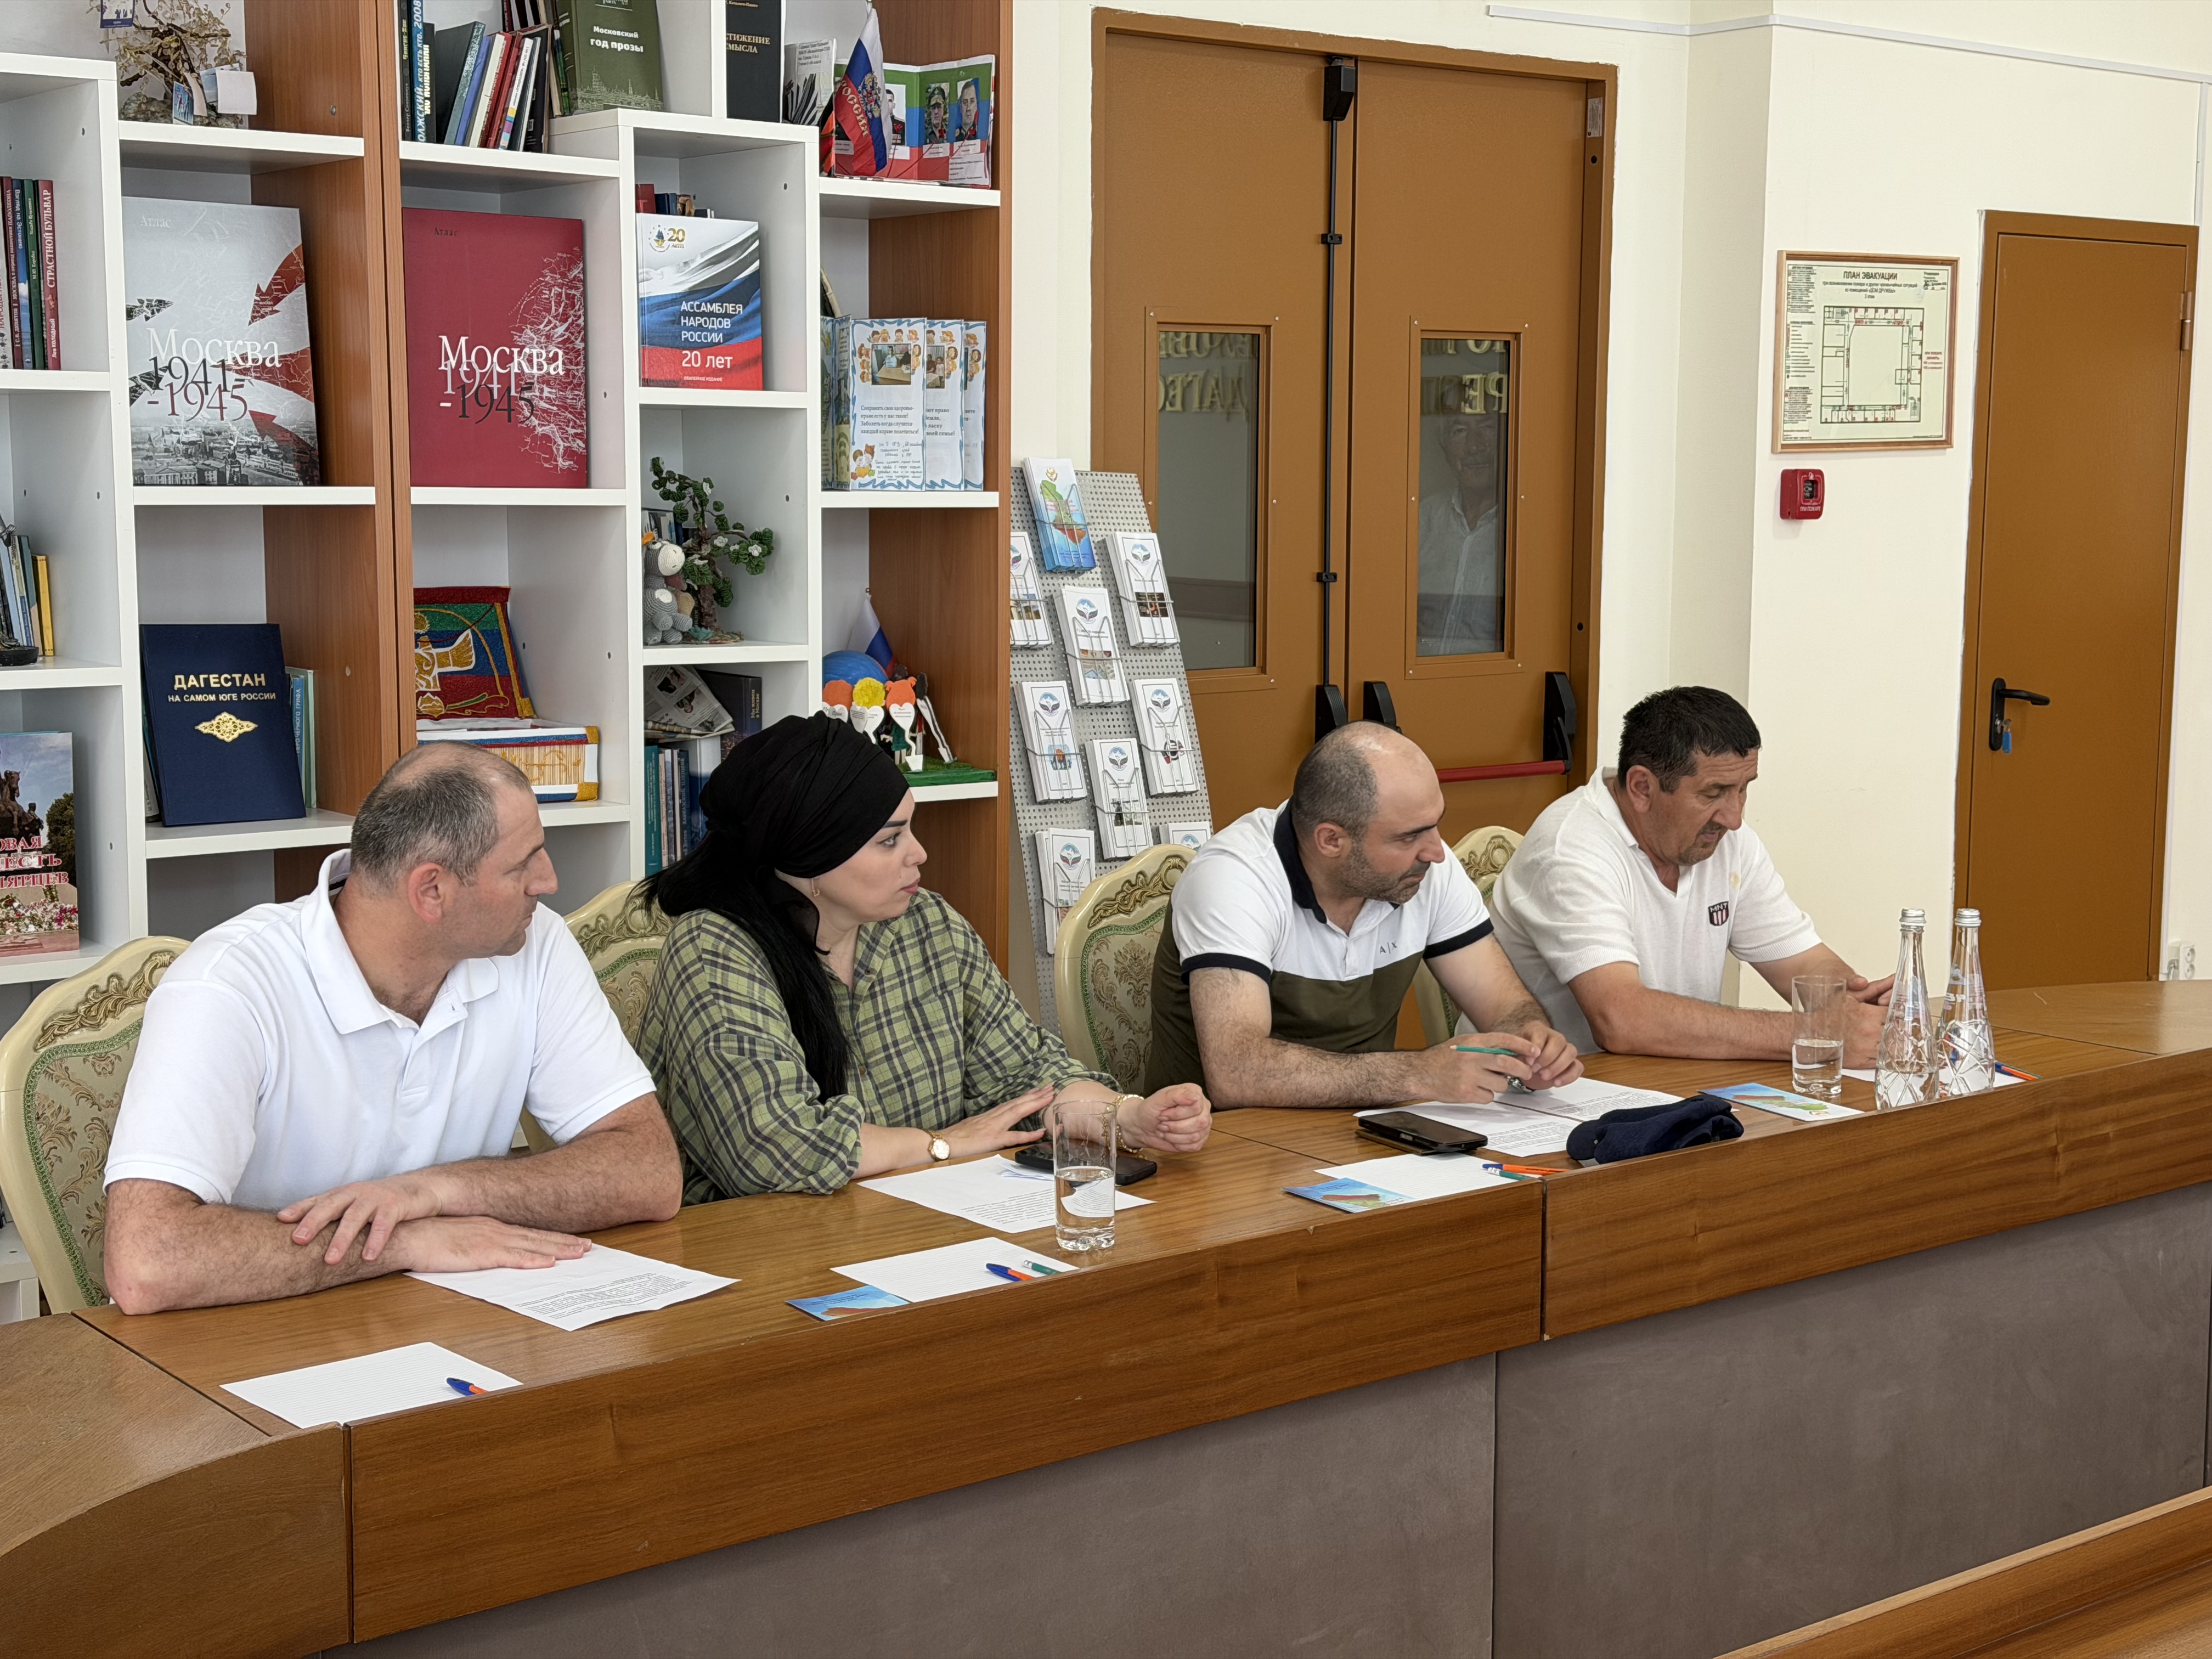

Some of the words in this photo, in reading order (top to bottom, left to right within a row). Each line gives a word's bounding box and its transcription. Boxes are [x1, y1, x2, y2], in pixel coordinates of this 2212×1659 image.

[413, 0, 422, 30] 2008
[593, 25, 639, 38] Московский
[590, 38, 610, 49] год
[611, 41, 644, 52] прозы
[43, 189, 53, 232] БУЛЬВАР
[667, 228, 686, 242] 20
[43, 233, 55, 288] СТРАСТНОЙ
[1861, 271, 1898, 281] ЭВАКУАЦИИ
[680, 301, 743, 314] АССАМБЛЕЯ
[681, 315, 731, 330] НАРОДОВ
[681, 330, 723, 343] РОССИИ
[146, 328, 283, 368] Москва
[438, 335, 566, 376] Москва
[681, 350, 701, 368] 20
[705, 356, 733, 369] лет
[173, 673, 267, 690] ДАГЕСТАН
[184, 693, 216, 702] САМОМ
[219, 693, 238, 701] ЮГЕ
[241, 692, 276, 701] РОССИИ
[0, 854, 63, 871] ЕСТЬ
[1710, 902, 1728, 912] MNT
